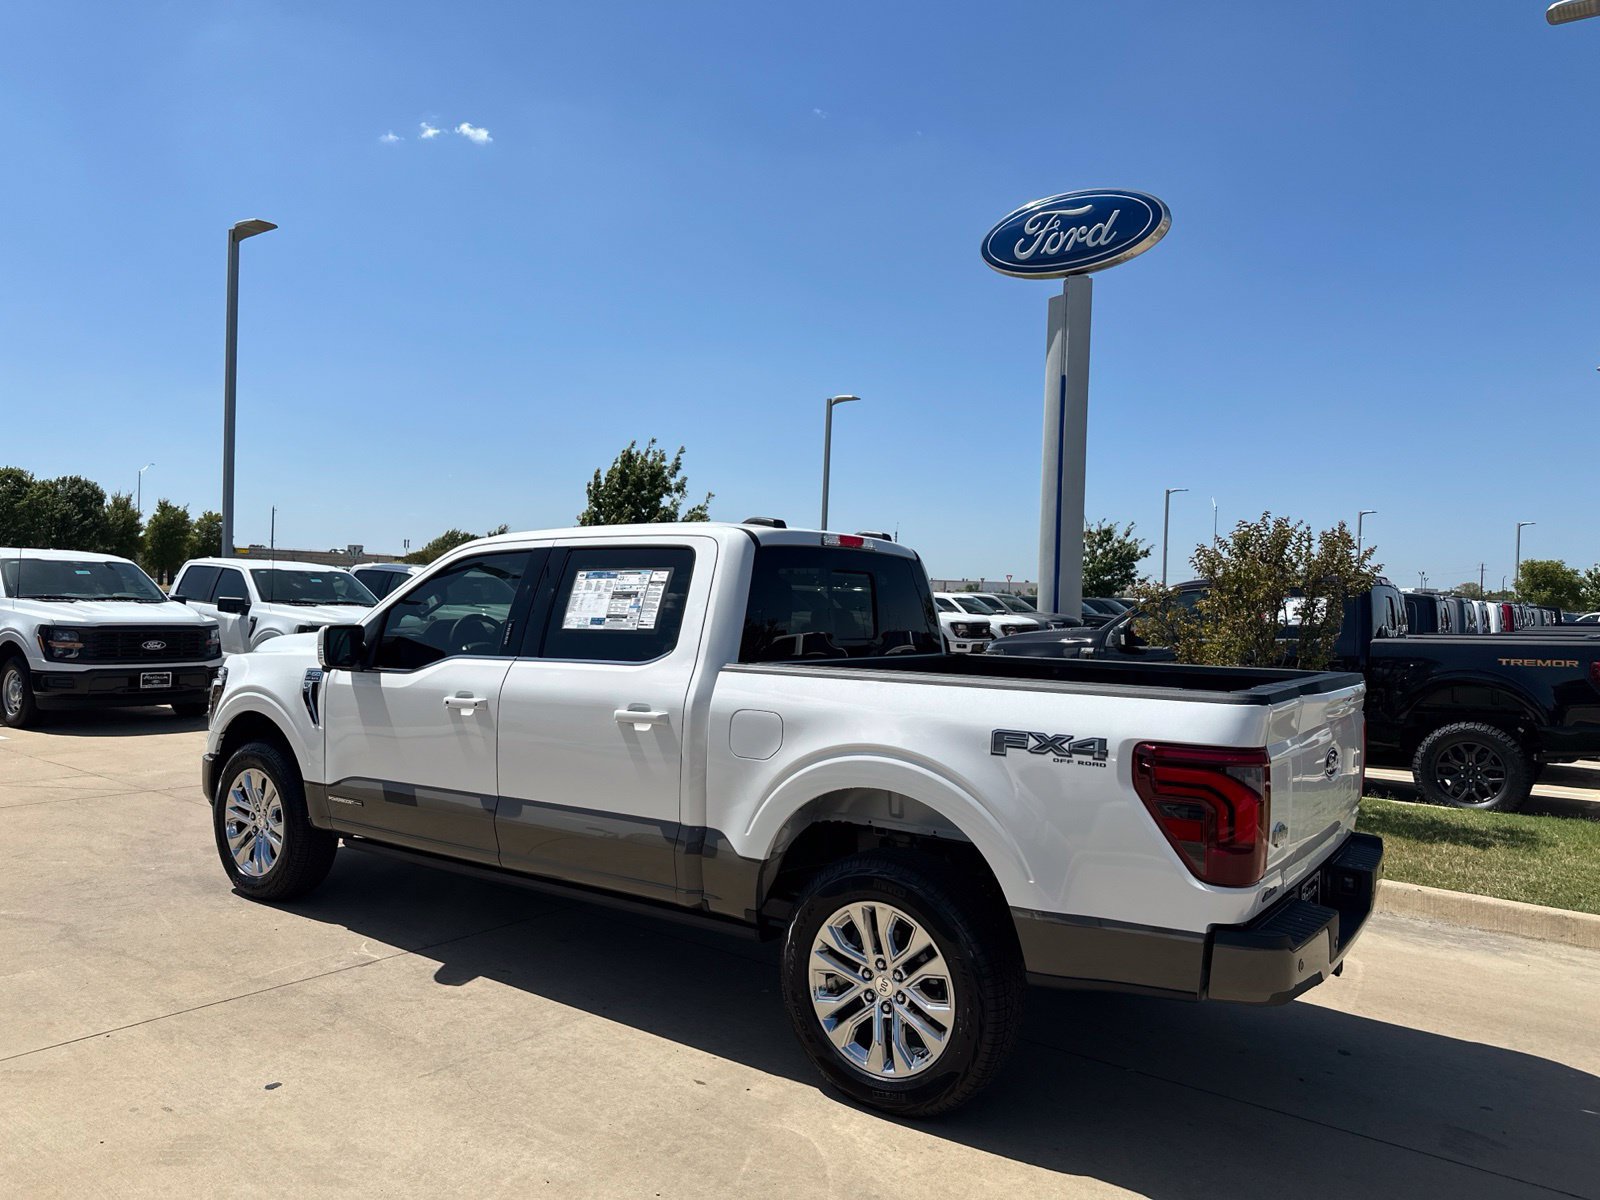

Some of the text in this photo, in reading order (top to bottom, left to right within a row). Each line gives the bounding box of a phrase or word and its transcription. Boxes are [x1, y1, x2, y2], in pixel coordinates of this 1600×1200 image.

[1014, 204, 1120, 260] Ford
[1497, 658, 1579, 668] TREMOR
[990, 728, 1108, 761] FX4
[1077, 760, 1107, 768] ROAD
